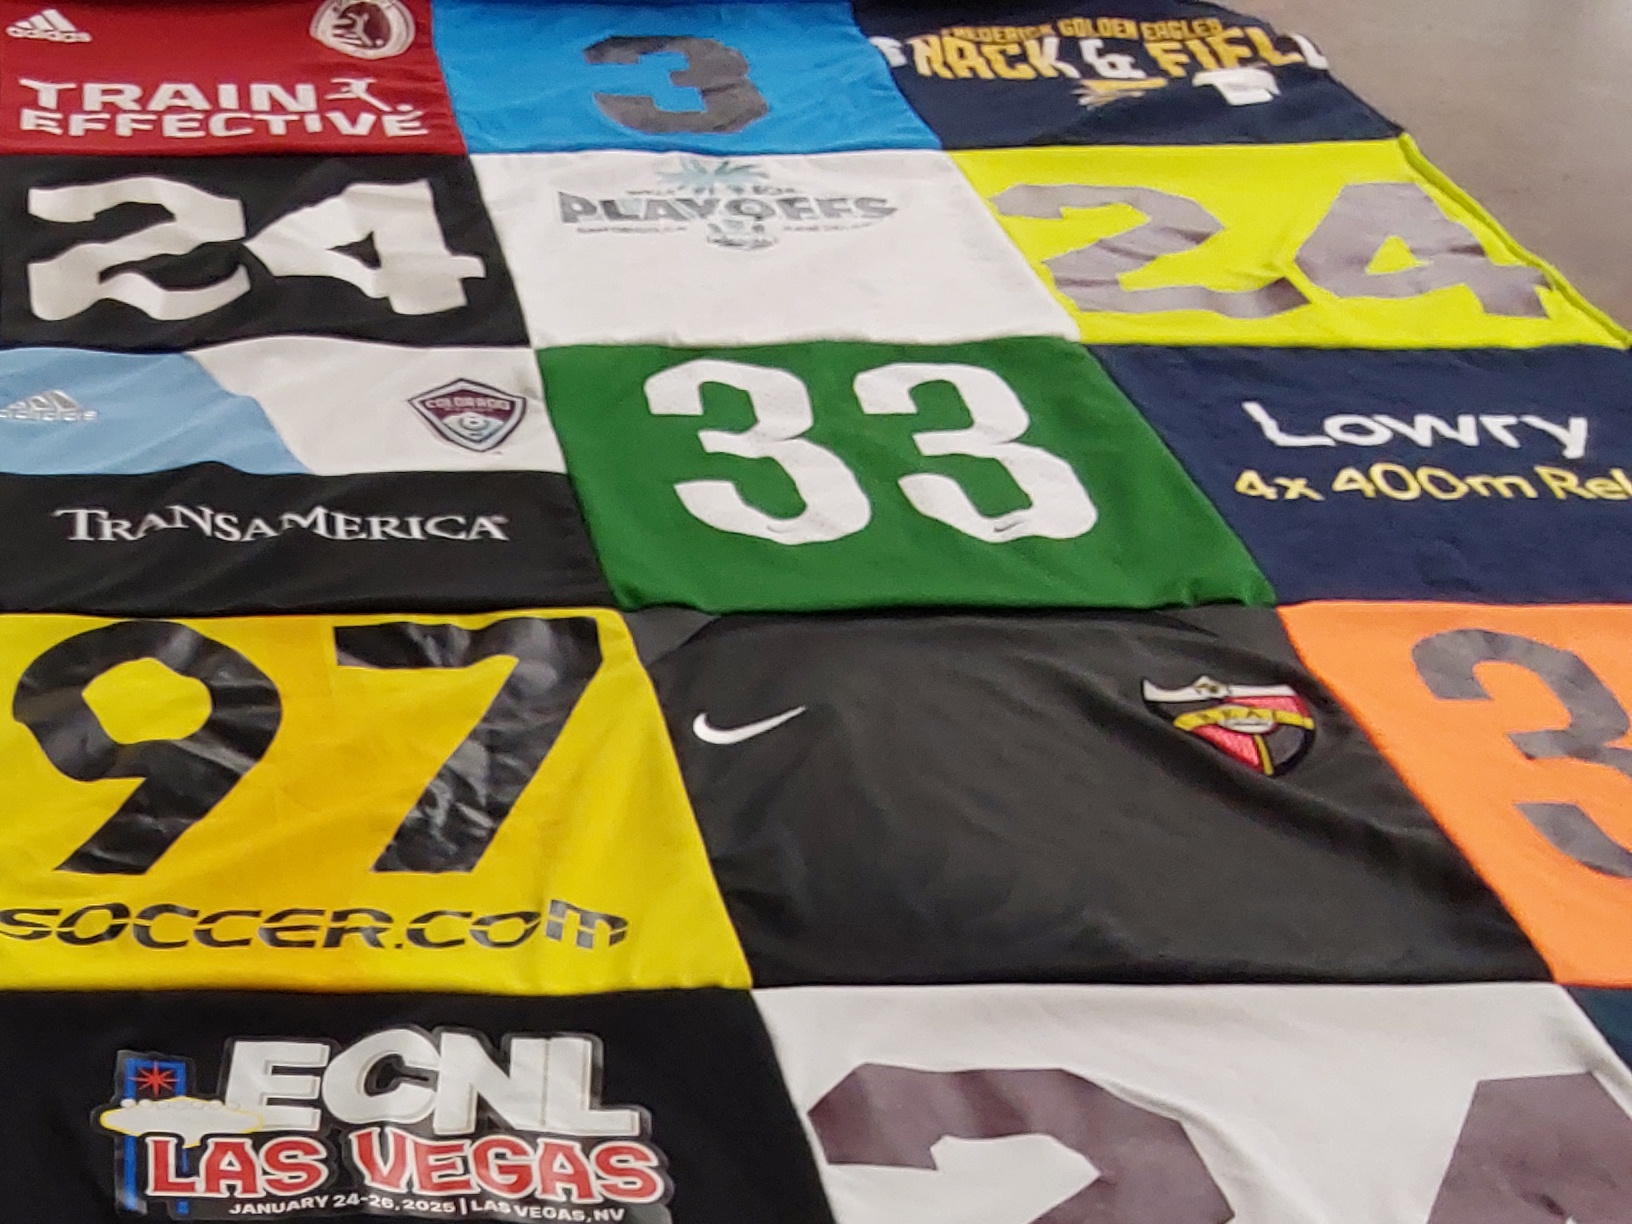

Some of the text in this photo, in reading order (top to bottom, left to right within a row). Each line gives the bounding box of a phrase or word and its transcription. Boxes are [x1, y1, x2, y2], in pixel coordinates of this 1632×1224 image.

[1058, 17, 1138, 39] GOLDEN
[582, 35, 770, 134] 3
[1078, 37, 1147, 79] &
[19, 78, 319, 113] TRAIN
[19, 108, 429, 138] EFFECTIVE
[558, 190, 898, 225] PLAYOFFS
[28, 176, 486, 321] 24
[990, 181, 1556, 318] 24
[643, 358, 1099, 545] 33
[1241, 401, 1588, 459] Lowry
[1235, 469, 1325, 501] 4x
[1331, 462, 1539, 500] 400m
[11, 616, 604, 876] 97
[224, 1028, 641, 1136] ECNL
[145, 1127, 668, 1203] LAS VEGAS
[228, 1194, 329, 1216] JANUARY
[470, 1200, 511, 1214] LAS
